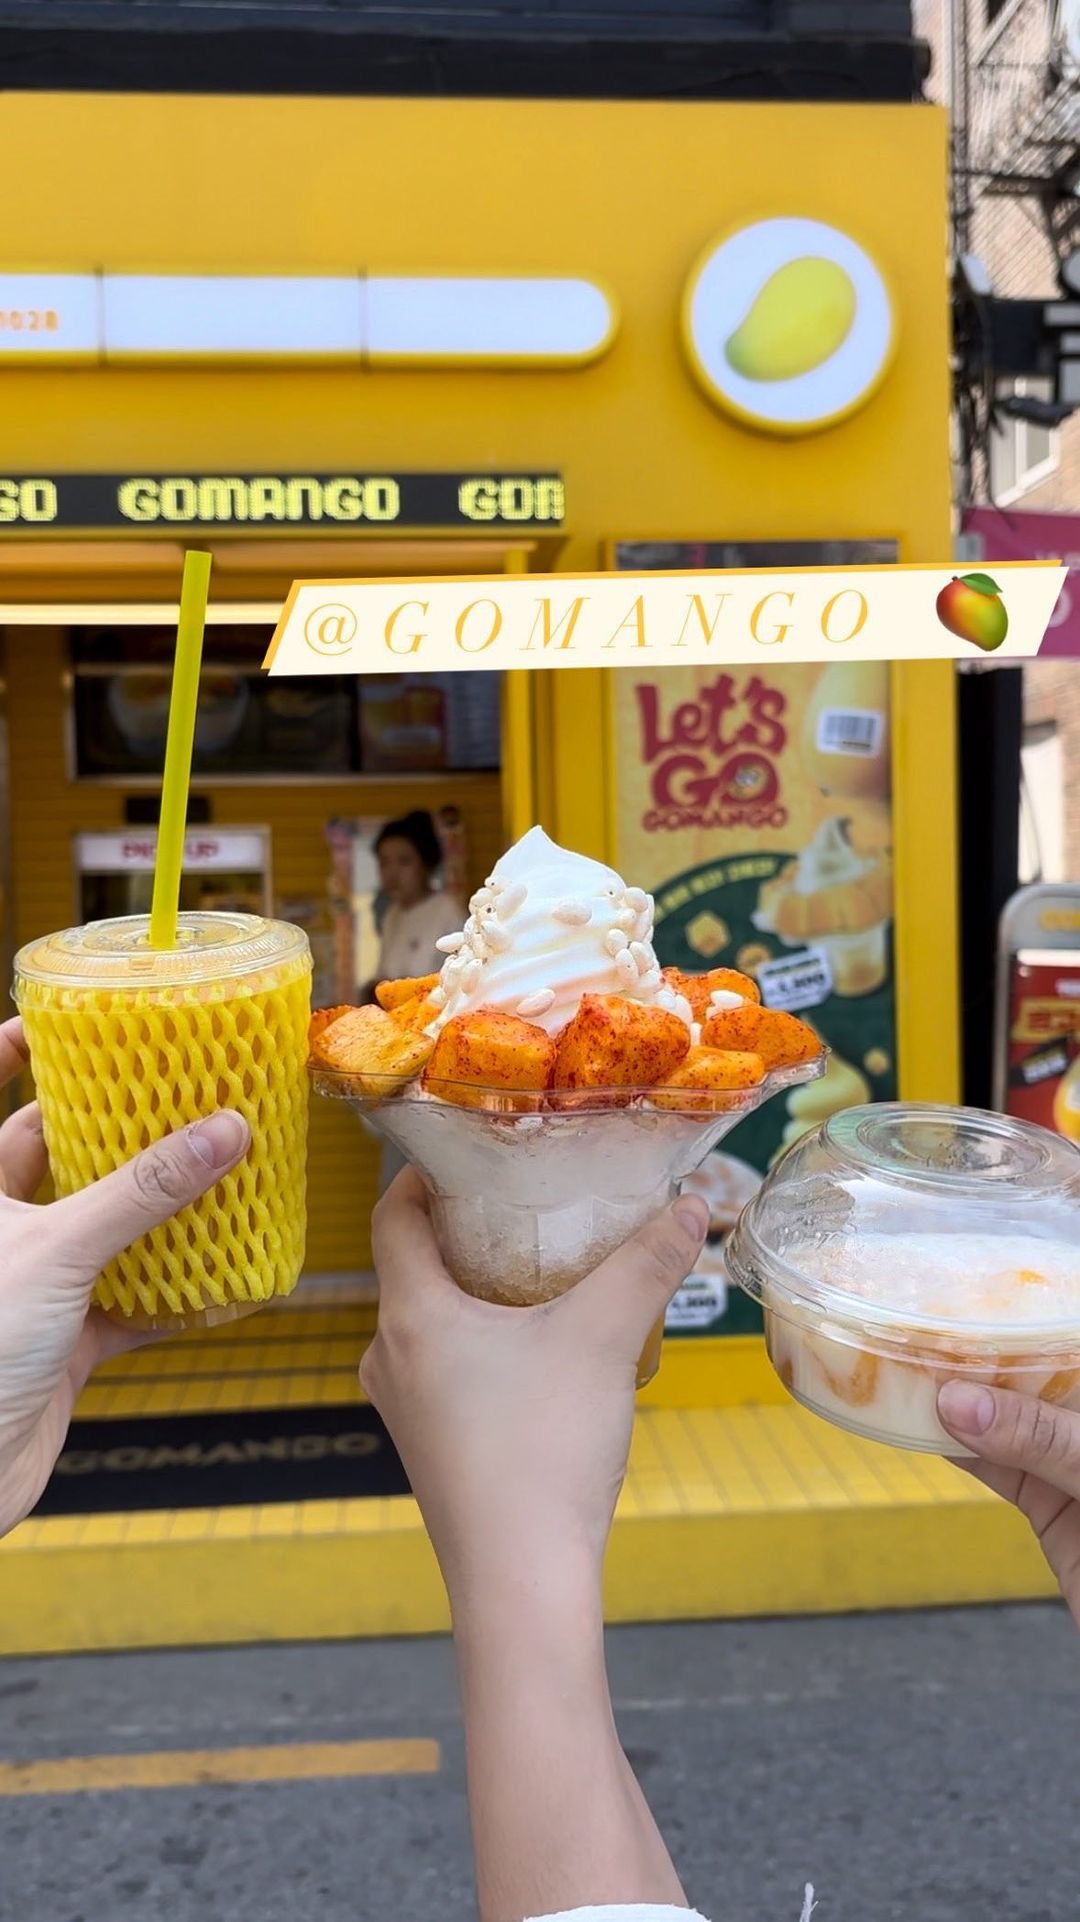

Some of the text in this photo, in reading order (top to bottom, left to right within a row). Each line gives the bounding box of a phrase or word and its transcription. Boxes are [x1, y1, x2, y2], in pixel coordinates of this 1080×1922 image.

[117, 477, 400, 521] GOMANGO
[634, 673, 788, 765] Let's
[652, 751, 780, 807] GO
